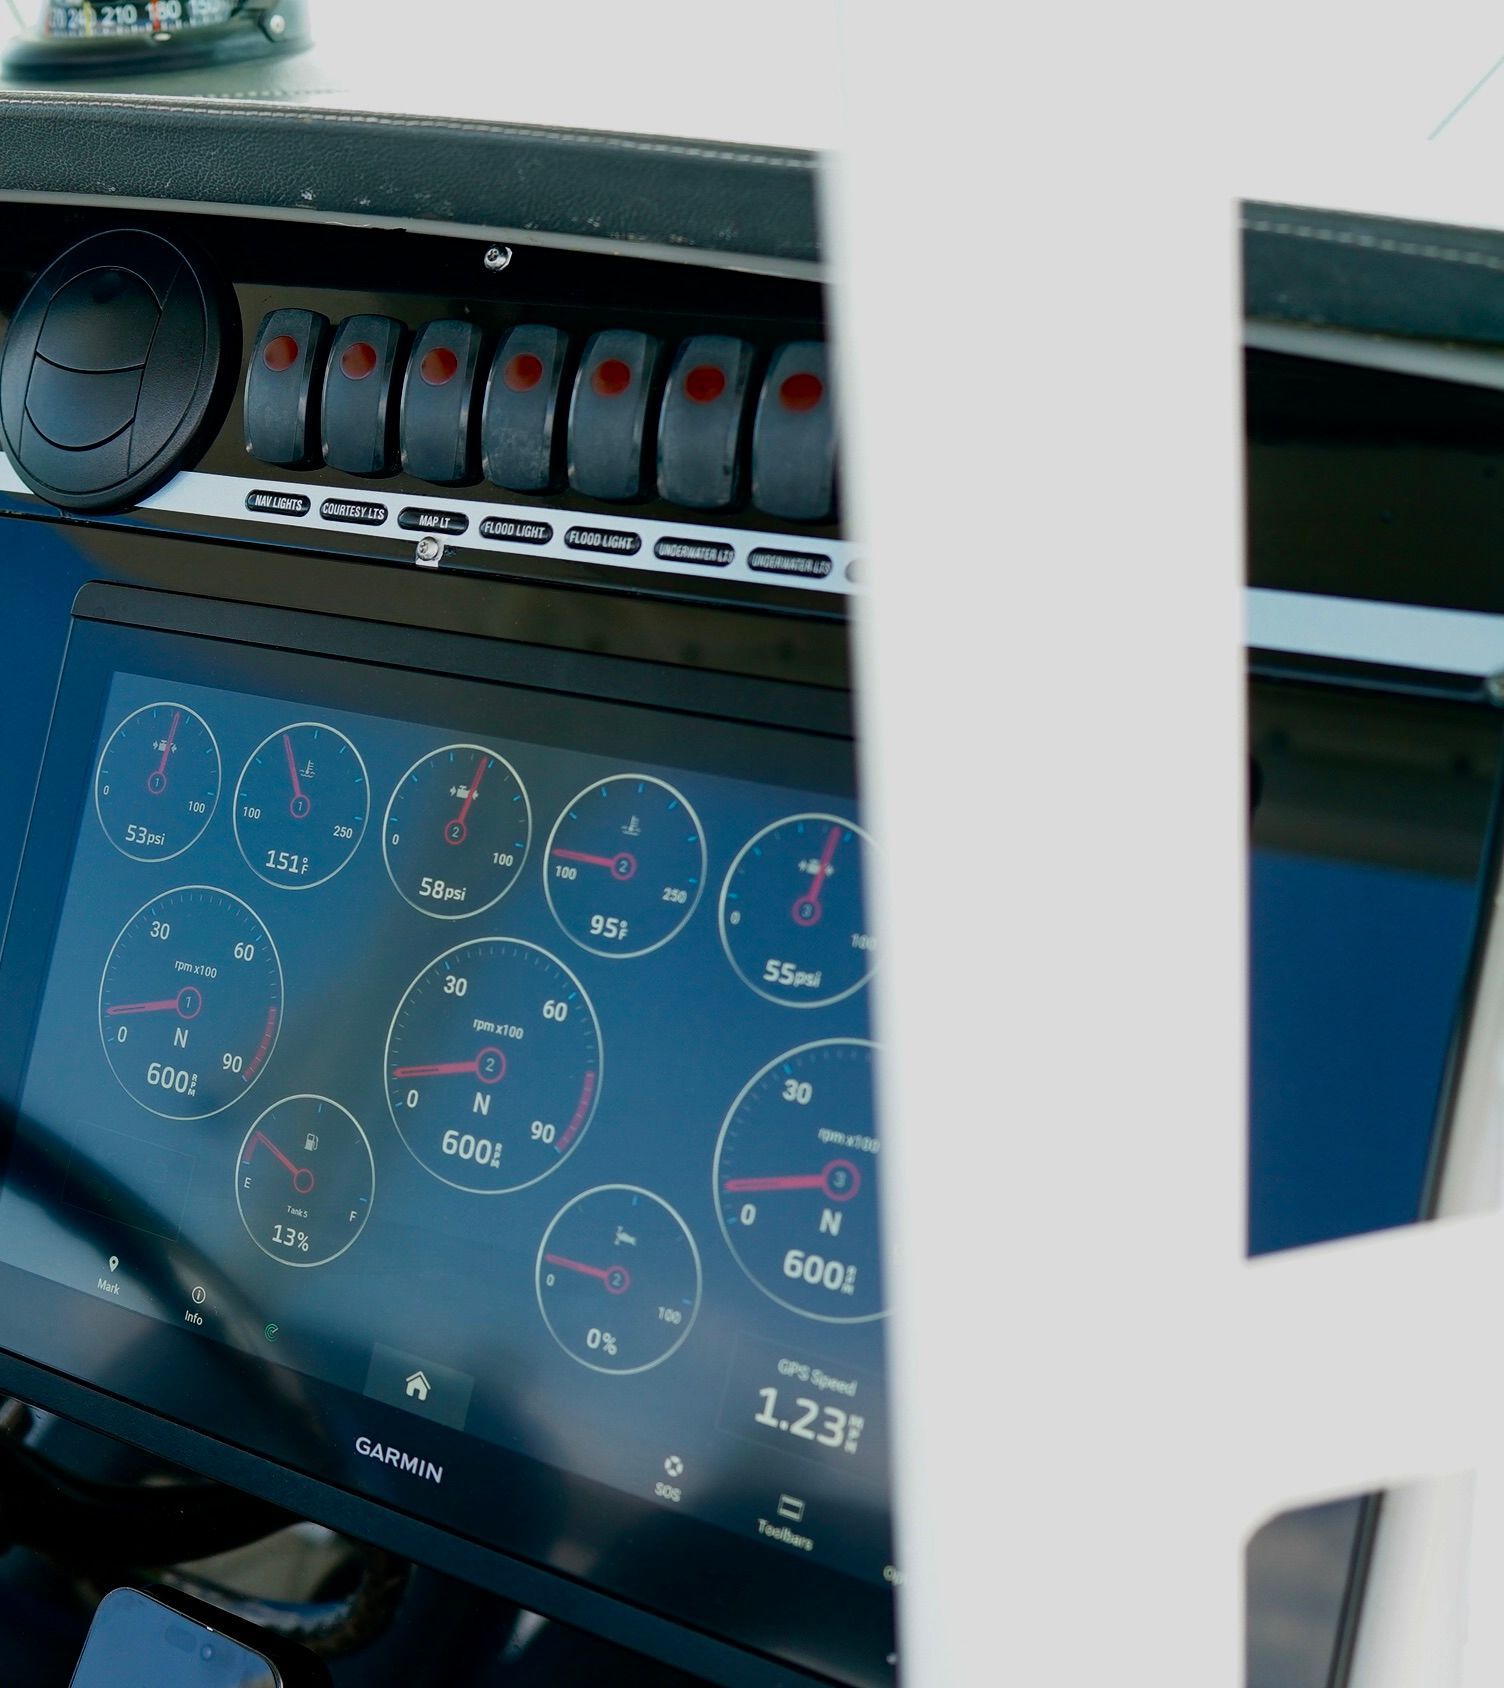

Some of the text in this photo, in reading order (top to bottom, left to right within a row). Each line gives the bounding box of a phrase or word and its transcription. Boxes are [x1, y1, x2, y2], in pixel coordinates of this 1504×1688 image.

[100, 4, 138, 26] 210
[254, 493, 304, 512] NAV LIGHTS
[322, 503, 385, 521] COURTESY LTS
[419, 514, 451, 529] MAP LT
[484, 521, 546, 540] FLOOD LIGHT
[569, 529, 634, 550] FLOOD LIGHT
[659, 542, 717, 562] UNDERWATER
[103, 785, 110, 796] 0
[187, 800, 206, 814] 100
[242, 806, 261, 820] 100
[333, 825, 353, 840] 250
[391, 833, 400, 846] 0
[452, 825, 460, 839] 2
[492, 852, 514, 867] 100
[619, 859, 628, 874] 2
[555, 864, 578, 881] 100
[662, 887, 687, 904] 250
[729, 910, 741, 926] 0
[150, 920, 170, 940] 30
[234, 942, 255, 962] 60
[174, 960, 217, 979] rpm x100
[443, 975, 468, 997] 30
[542, 1000, 568, 1022] 60
[117, 1026, 128, 1043] 0
[173, 1027, 188, 1049] N
[472, 1018, 524, 1040] rpm x100
[222, 1052, 243, 1073] 90
[485, 1057, 495, 1072] 2
[406, 1089, 419, 1108] 0
[782, 1078, 813, 1105] 30
[472, 1092, 491, 1116] N
[530, 1120, 556, 1144] 90
[244, 1177, 252, 1189] E
[834, 1171, 846, 1188] 3
[287, 1205, 303, 1218] Tank
[349, 1210, 358, 1222] F
[740, 1203, 756, 1226] 0
[819, 1208, 843, 1237] N
[271, 1224, 309, 1252] 13%
[97, 1277, 120, 1296] Mark
[546, 1273, 555, 1287] 0
[611, 1273, 622, 1287] 2
[184, 1309, 204, 1327] Info
[658, 1306, 682, 1325] 100
[586, 1327, 618, 1356] 0%
[777, 1358, 858, 1397] GPS Speed
[754, 1387, 846, 1448] 1.23
[355, 1436, 444, 1484] GARMIN
[654, 1481, 681, 1503] SOS
[758, 1517, 814, 1552] Toolbars
